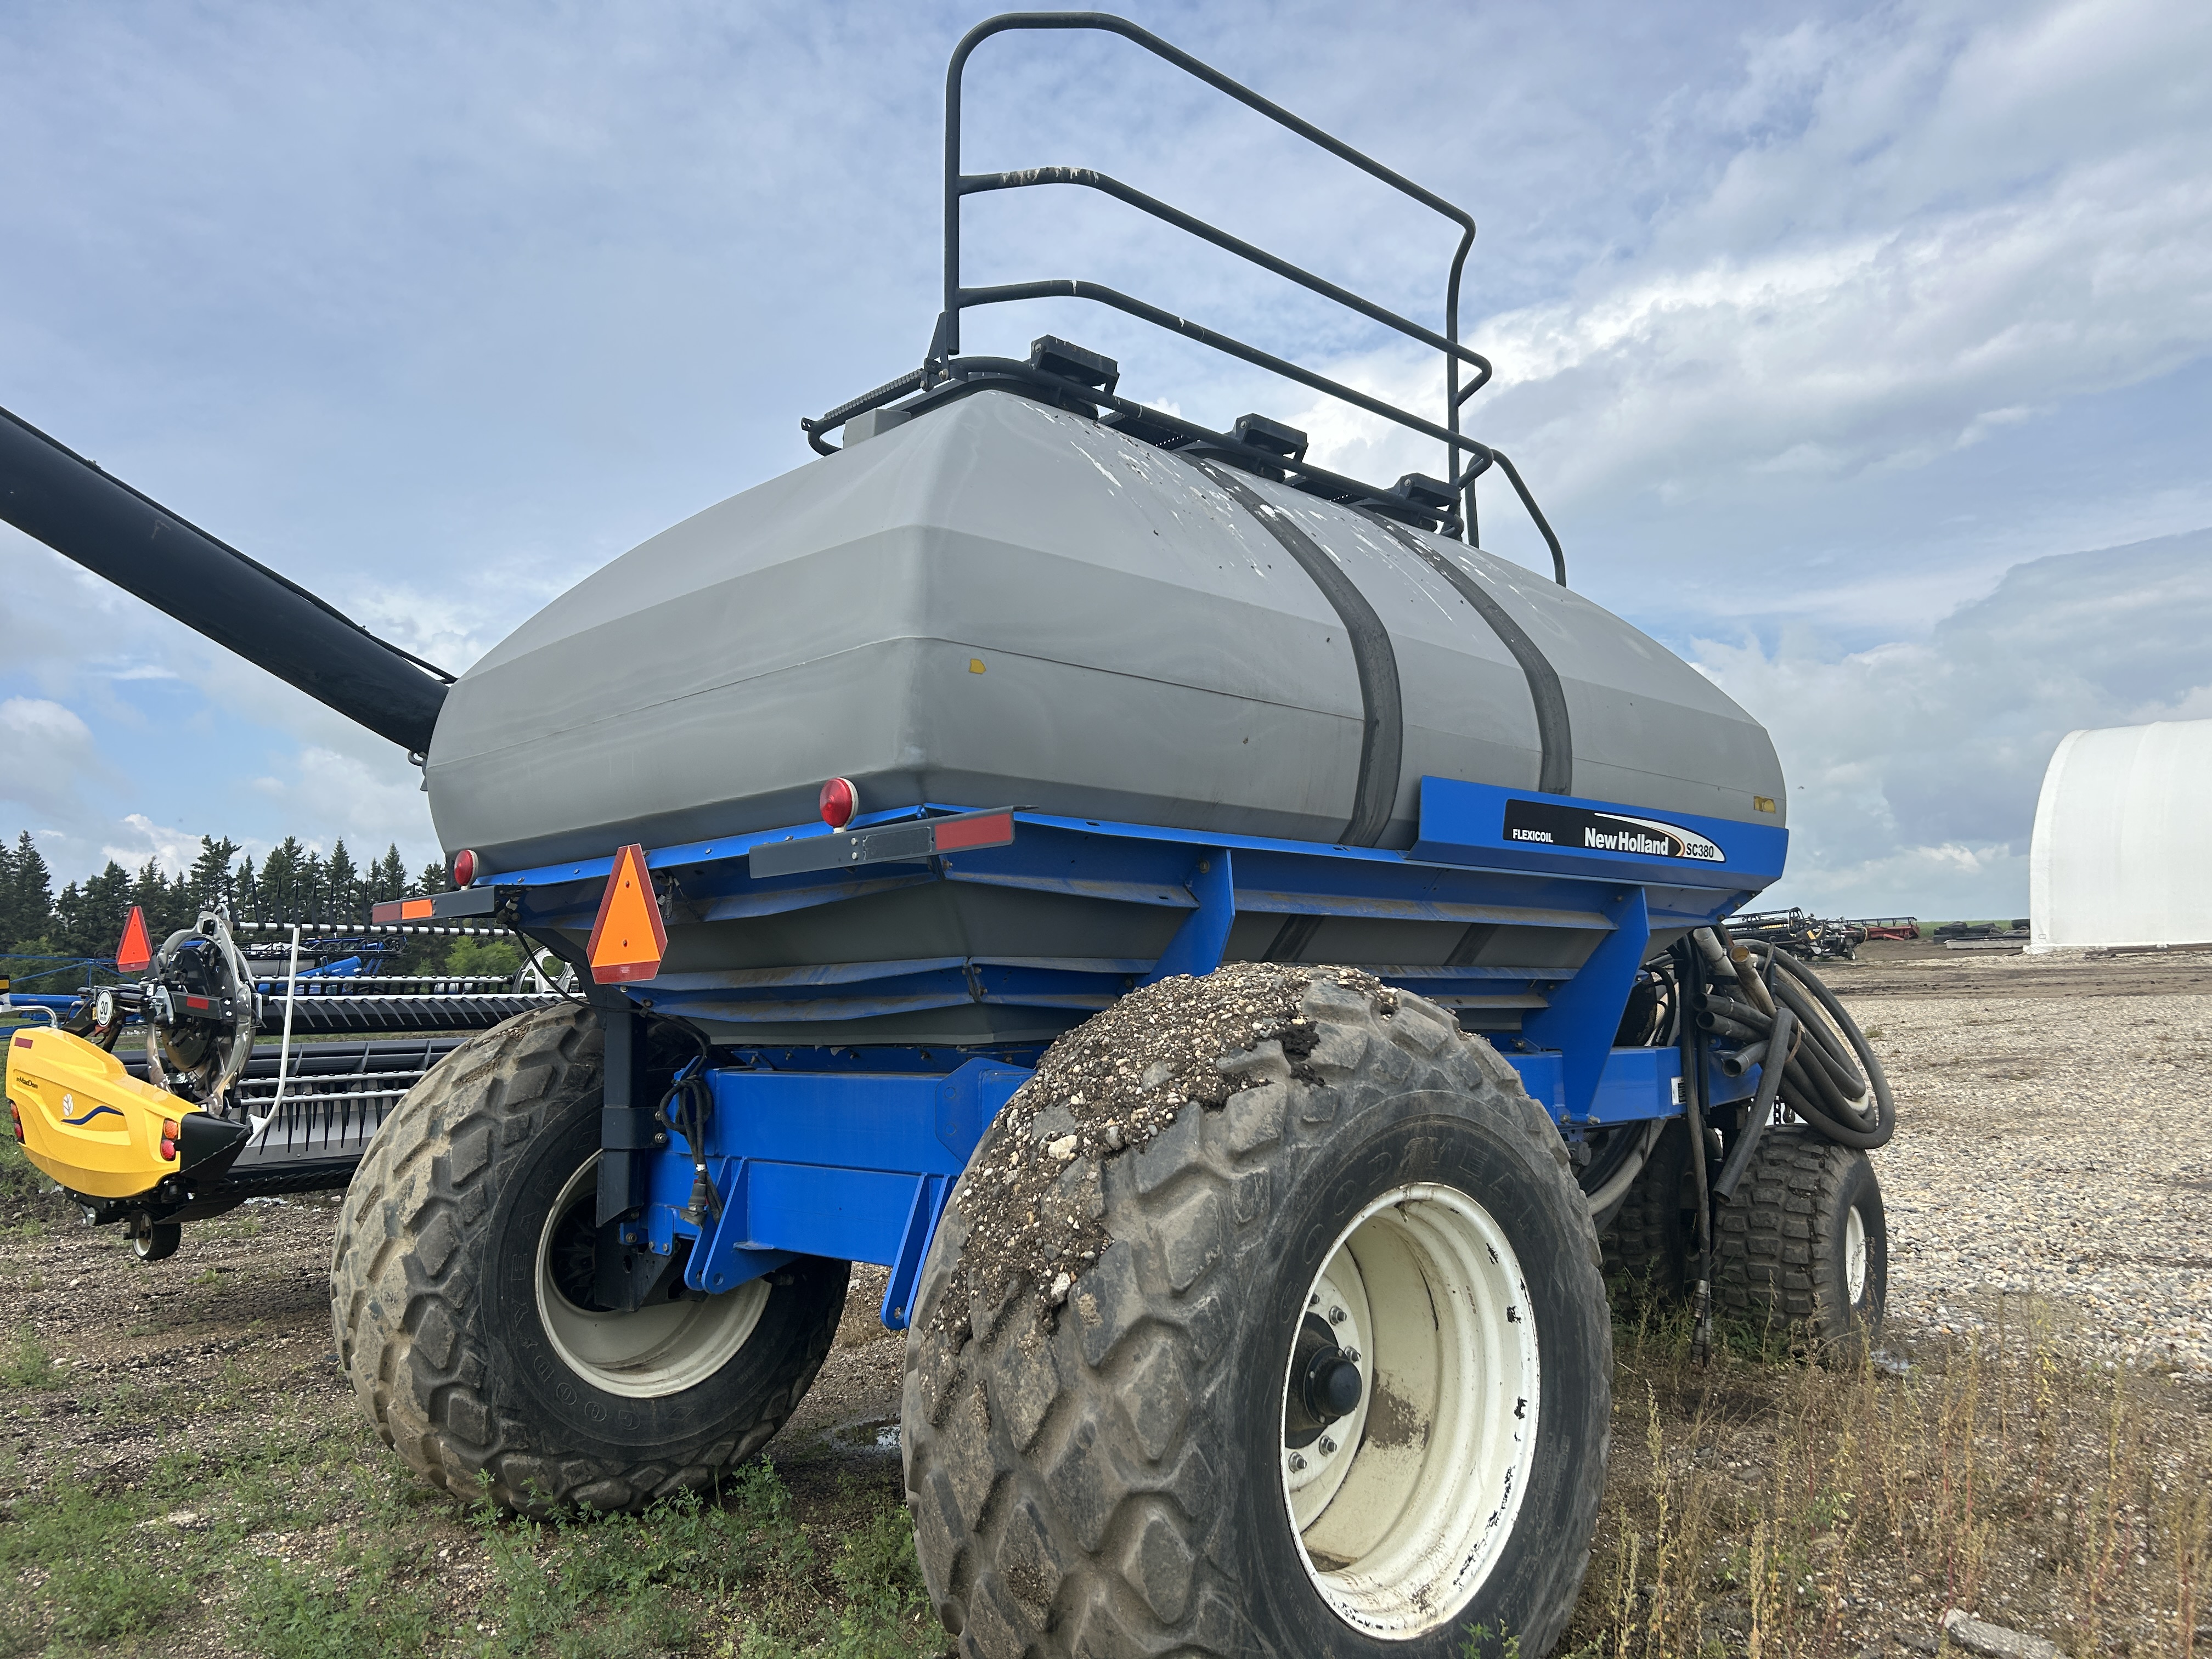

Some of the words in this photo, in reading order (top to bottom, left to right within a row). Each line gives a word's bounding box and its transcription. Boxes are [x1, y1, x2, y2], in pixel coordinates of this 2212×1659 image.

[1513, 829, 1554, 843] FLEXICOIL
[1584, 827, 1617, 850] New
[1618, 831, 1669, 856] Holland
[1686, 843, 1714, 859] SC380
[100, 1001, 108, 1015] 30
[19, 1076, 38, 1089] MacDon
